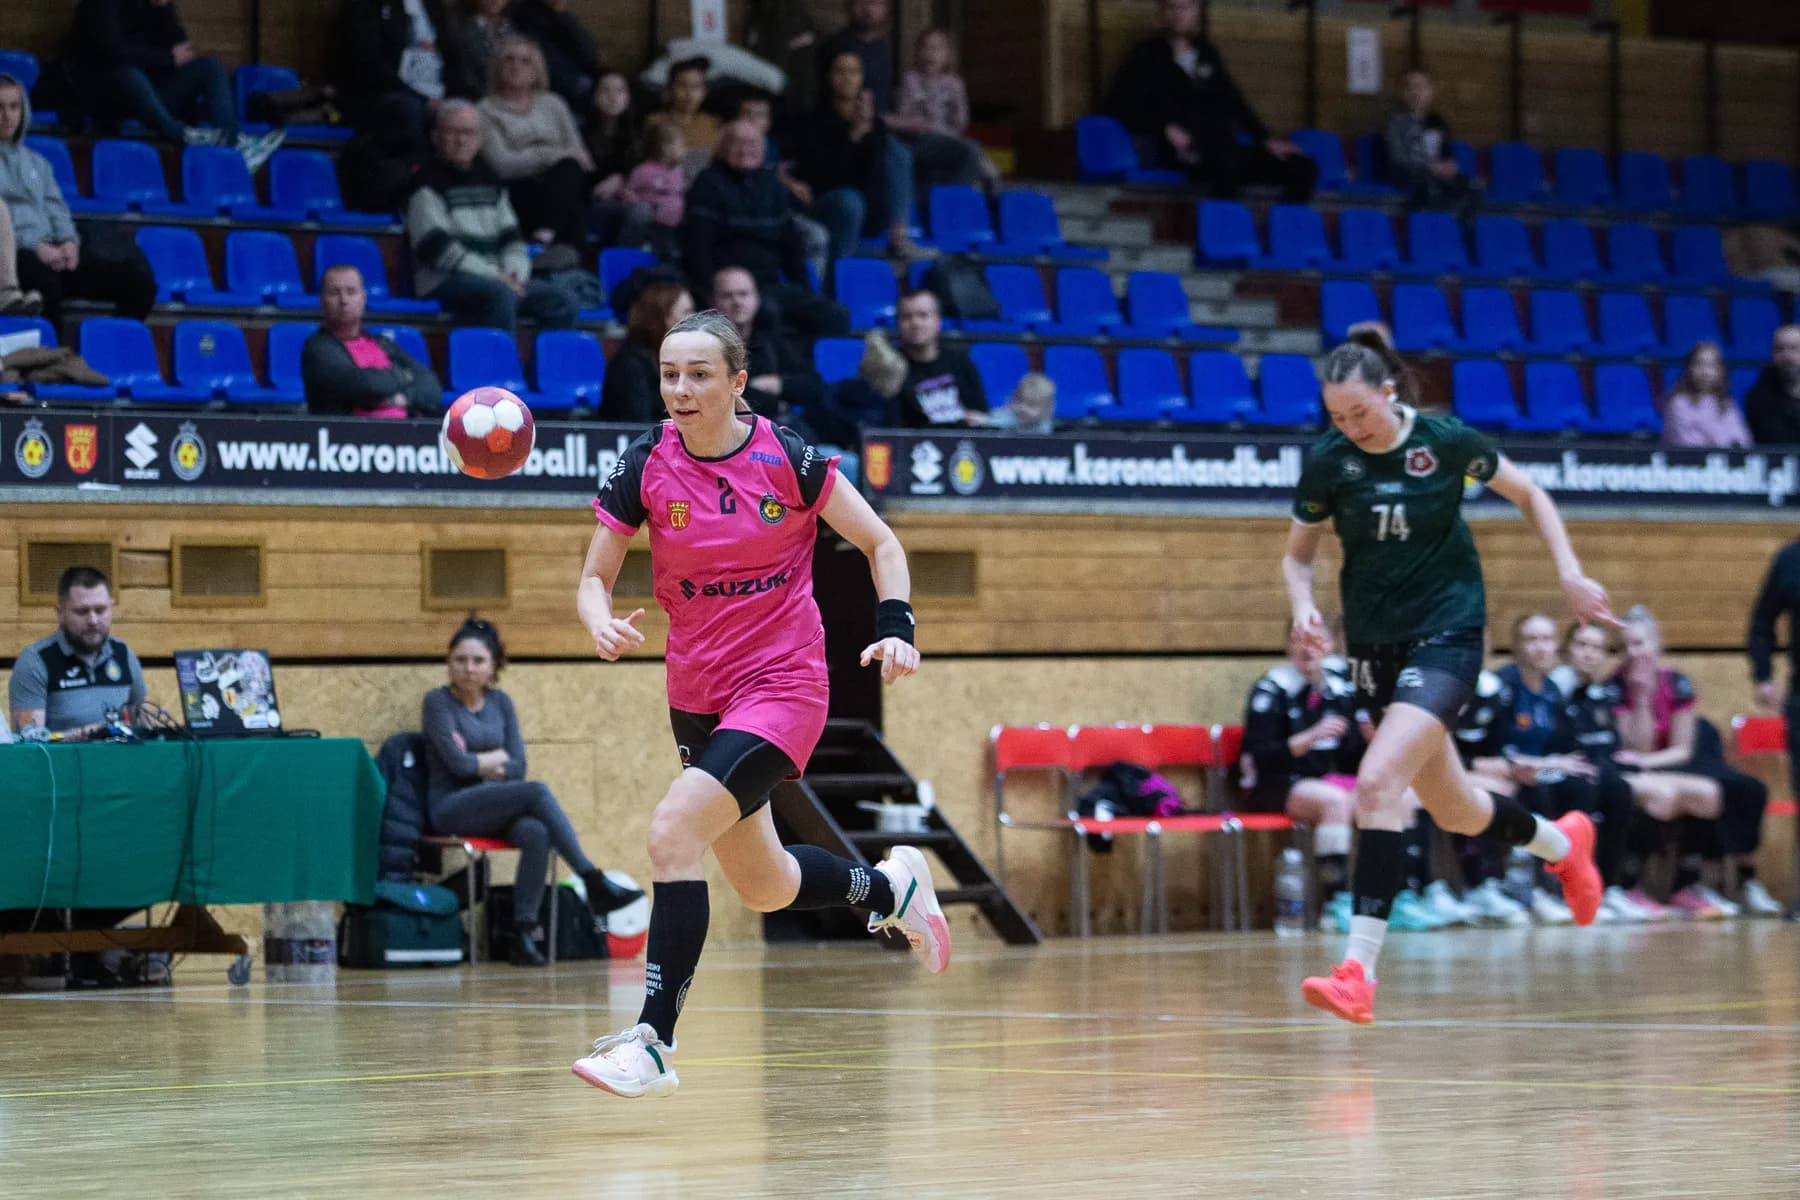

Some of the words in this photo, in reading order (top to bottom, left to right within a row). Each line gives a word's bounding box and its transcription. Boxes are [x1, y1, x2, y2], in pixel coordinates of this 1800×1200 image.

[217, 427, 629, 490] www.koronahball.pl
[990, 443, 1302, 489] www.koronahandball
[1512, 449, 1797, 507] w.koronahandball.pl
[716, 476, 737, 515] 2
[670, 511, 687, 528] CK
[1370, 503, 1412, 542] 74
[1347, 656, 1377, 697] 74
